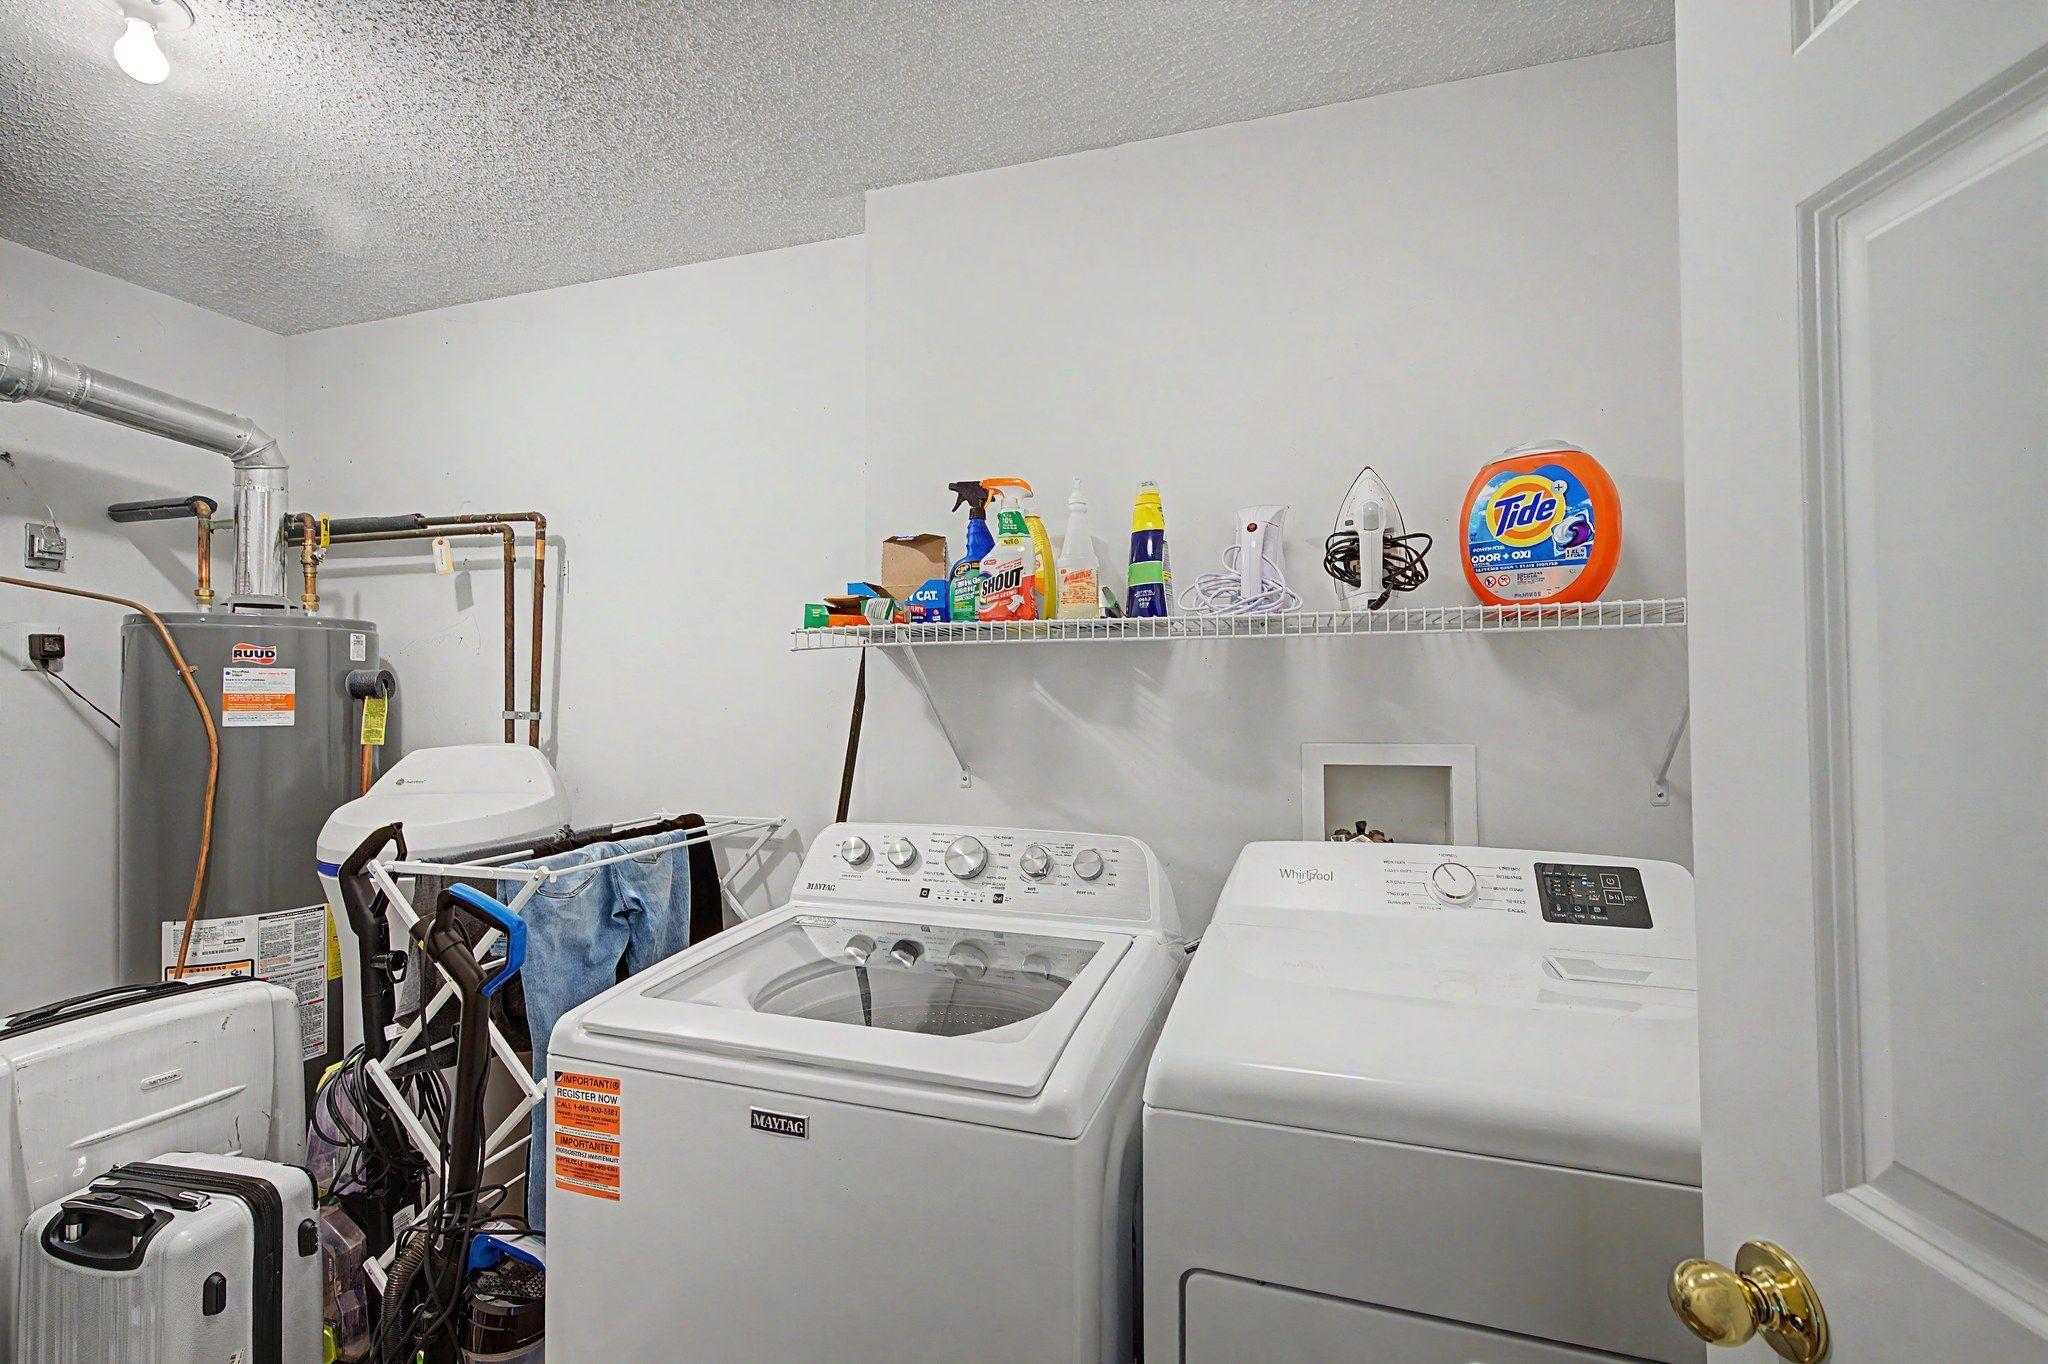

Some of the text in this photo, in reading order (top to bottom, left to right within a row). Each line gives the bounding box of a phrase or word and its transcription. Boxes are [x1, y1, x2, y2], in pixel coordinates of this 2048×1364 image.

[1494, 492, 1557, 537] Tide
[1471, 553, 1501, 564] ODOR
[1511, 550, 1532, 560] OXI
[982, 566, 1024, 596] SHOUT
[233, 649, 276, 658] RUUD
[1279, 868, 1333, 885] Whirlpool
[806, 882, 836, 892] MAYTAG
[557, 1087, 618, 1105] REGISTER NOW
[556, 1100, 572, 1110] CALL
[753, 1113, 804, 1134] MAYTAG
